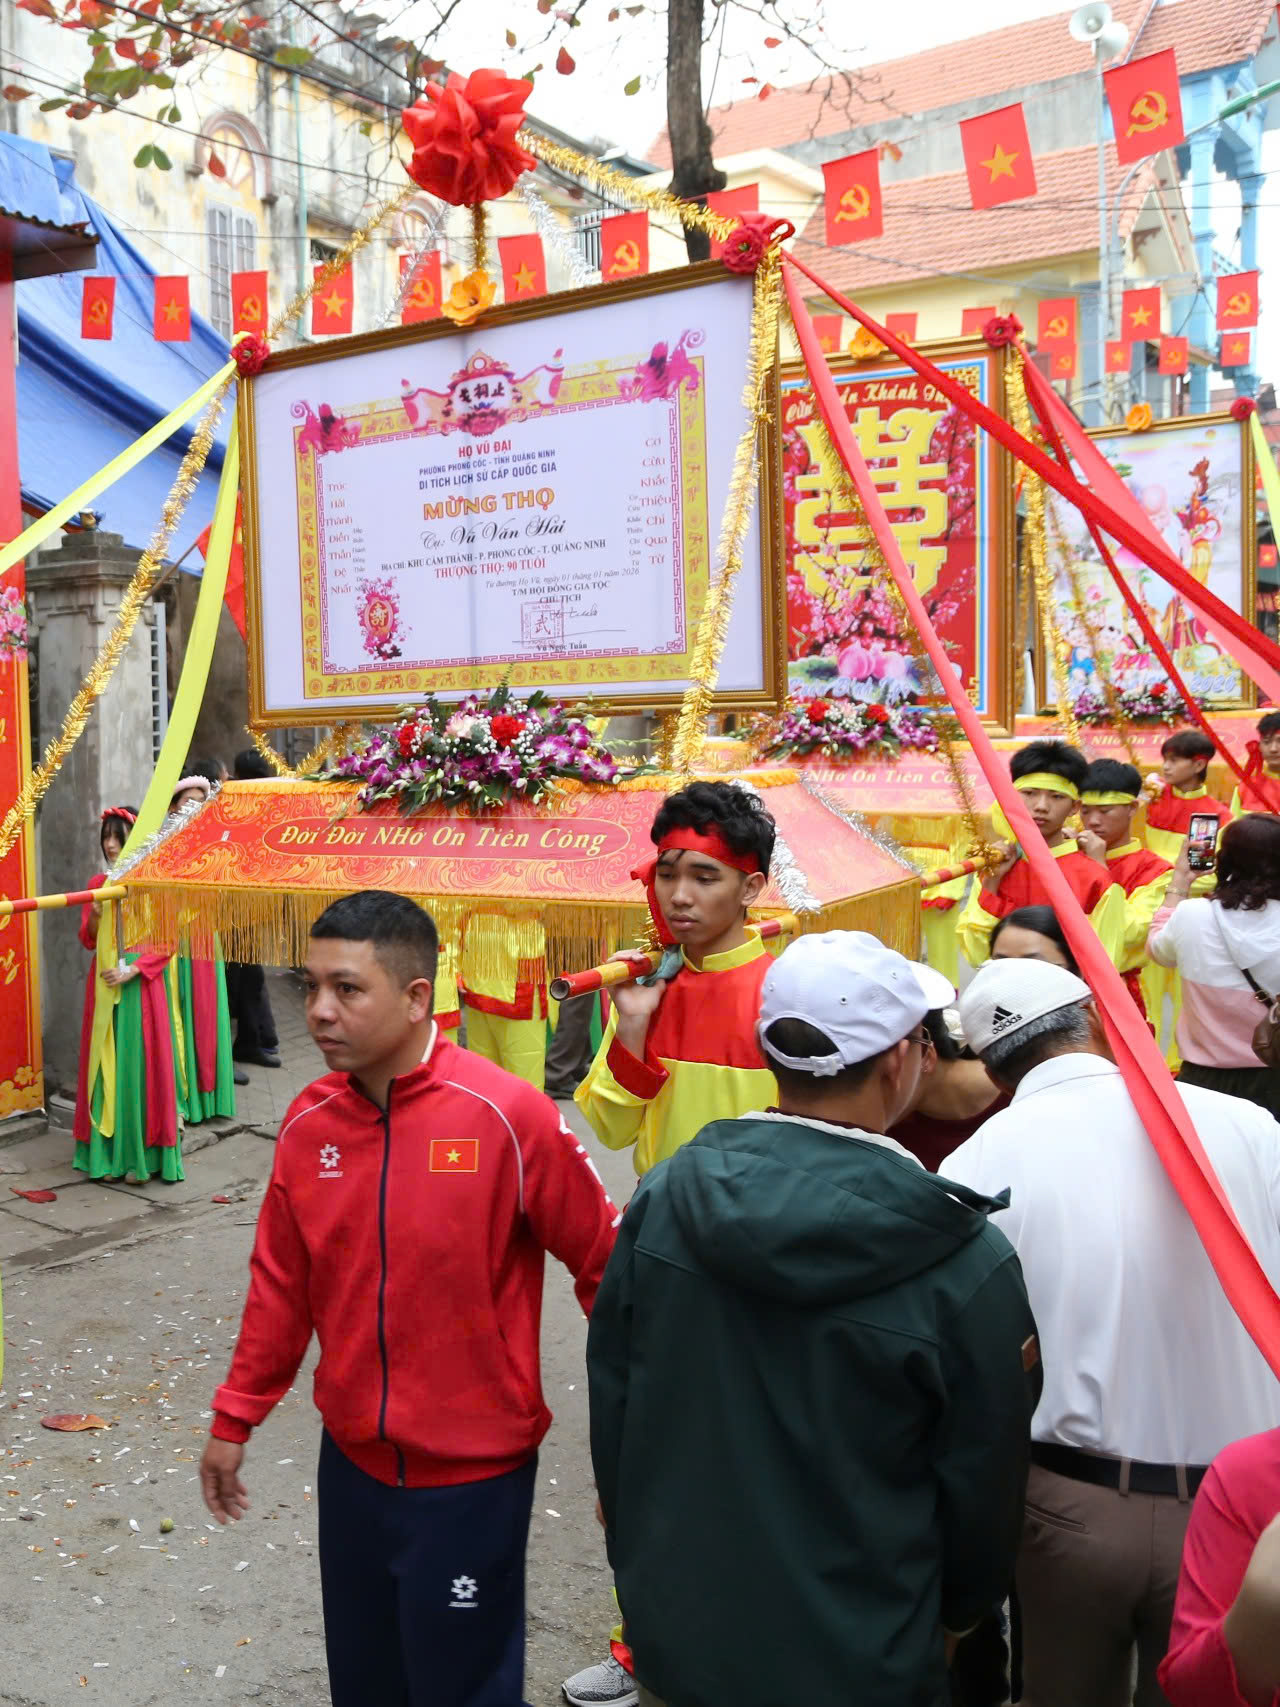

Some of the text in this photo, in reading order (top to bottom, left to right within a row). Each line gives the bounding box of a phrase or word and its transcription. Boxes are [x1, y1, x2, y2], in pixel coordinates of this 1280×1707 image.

[448, 460, 471, 472] PHONG
[538, 449, 556, 459] NINH
[458, 439, 512, 460] HỌ VŨ ĐẠI
[419, 480, 428, 490] DI
[430, 476, 451, 488] TÍCH
[454, 473, 474, 487] LỊCH
[541, 462, 557, 473] GIA
[423, 487, 556, 520] MỪNG THỌ
[482, 518, 519, 541] Văn
[408, 558, 424, 568] KHU
[488, 548, 516, 560] PHONG
[584, 539, 606, 550] NINH
[434, 566, 478, 580] THƯỢNG
[507, 560, 518, 572] 90
[574, 582, 590, 591] GIA
[278, 824, 607, 857] Đời Đời NHớ Ơn Tiên Công
[992, 1014, 1022, 1034] adidas
